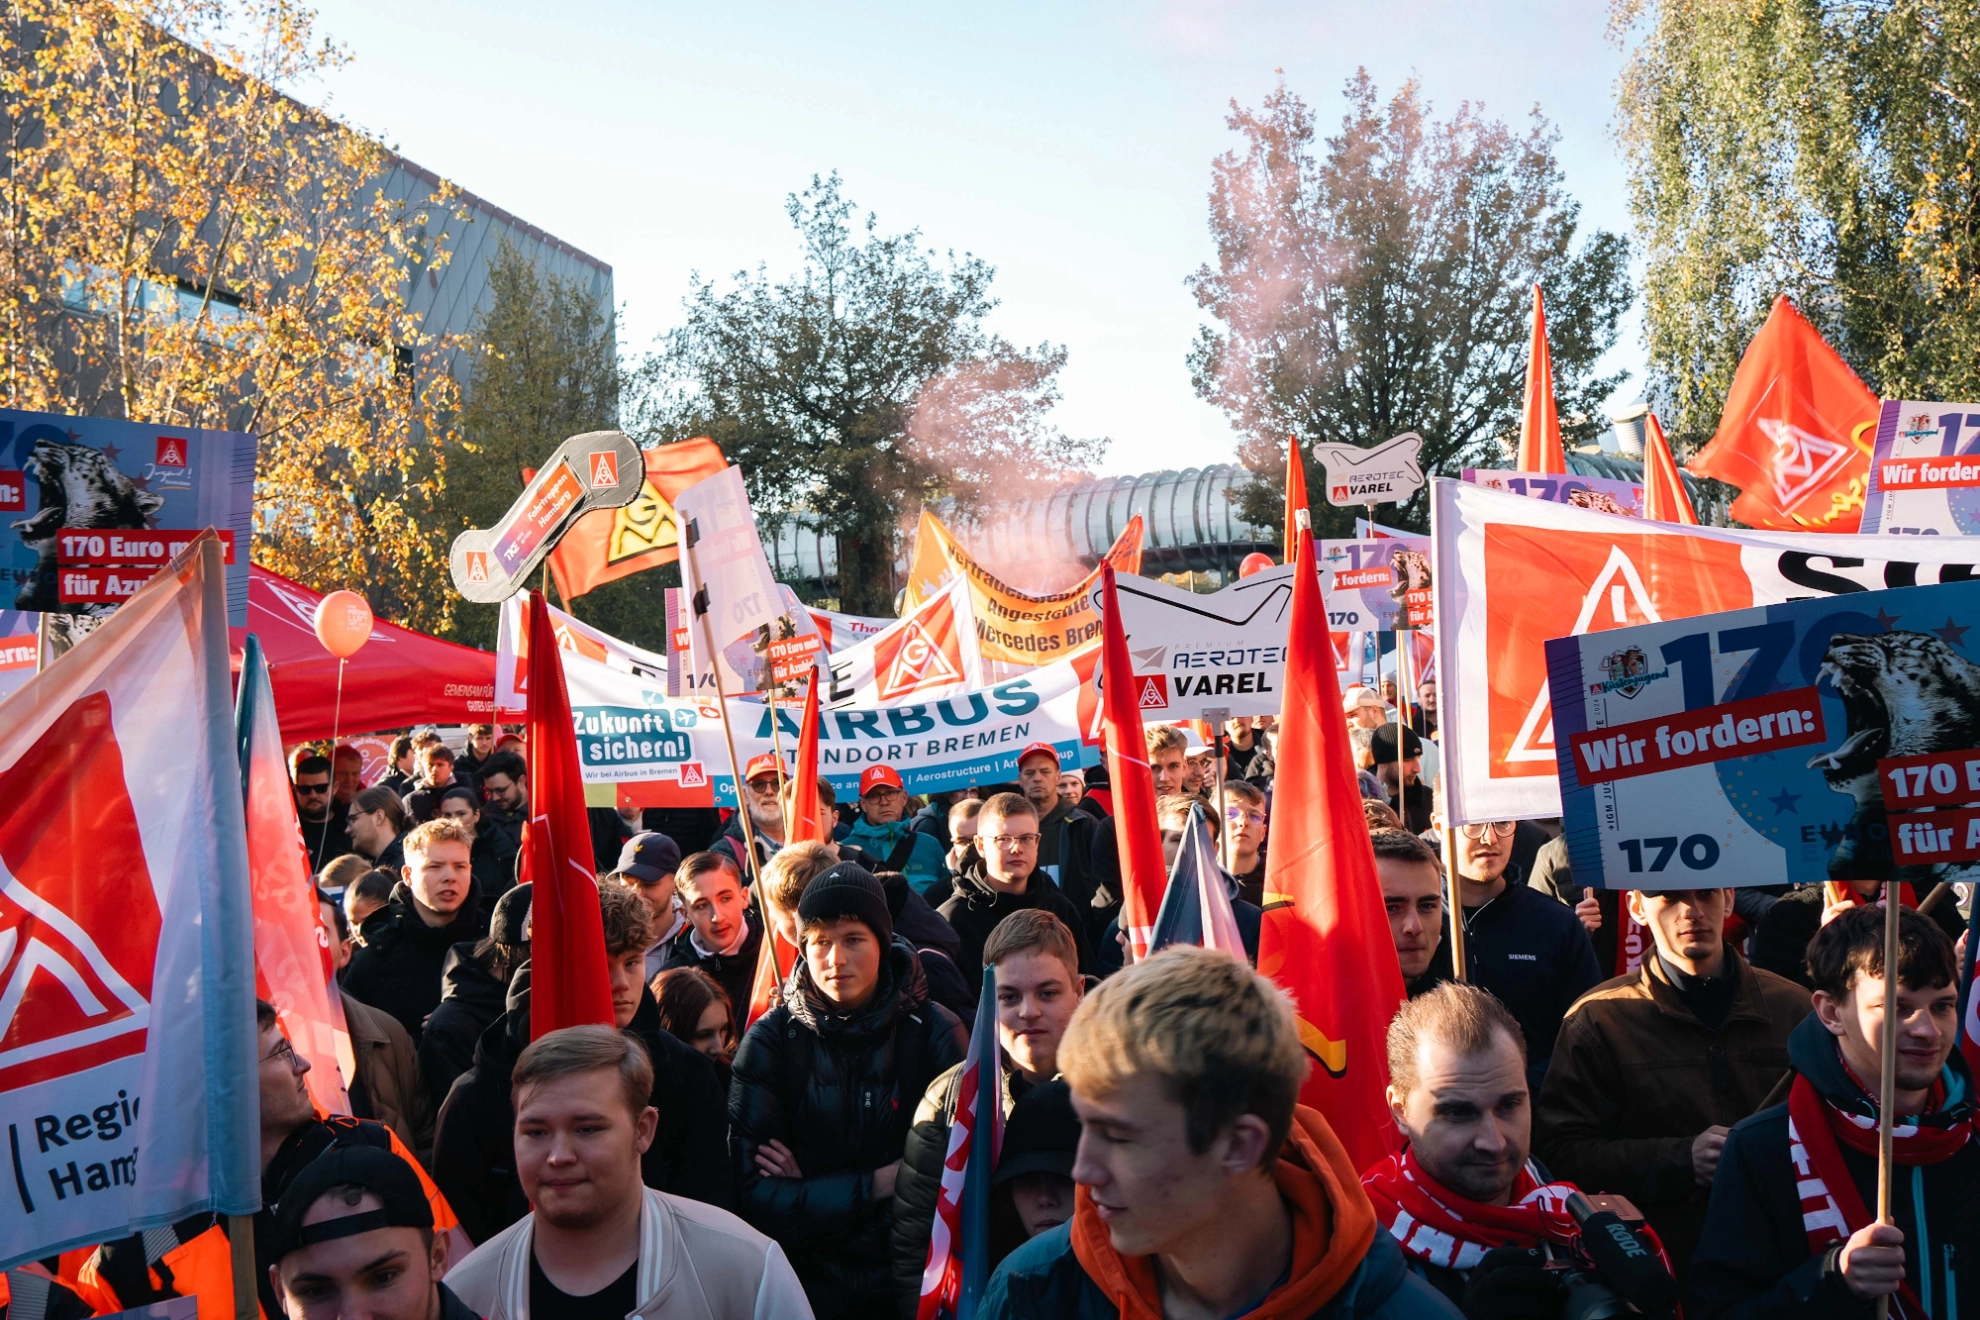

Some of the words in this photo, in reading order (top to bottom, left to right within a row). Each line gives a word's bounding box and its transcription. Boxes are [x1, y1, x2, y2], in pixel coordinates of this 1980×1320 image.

[1349, 470, 1405, 483] AEROTEC
[1882, 464, 1916, 484] Wir
[527, 474, 568, 522] Fahrtreppen
[1350, 482, 1393, 495] VAREL
[537, 489, 572, 528] Hamburg
[61, 536, 105, 558] 170
[110, 536, 164, 558] Euro
[64, 574, 99, 596] für
[1342, 571, 1390, 586] fordern:
[1408, 591, 1425, 603] 170
[1328, 611, 1359, 625] 170
[1409, 609, 1425, 622] für
[974, 616, 1061, 652] Mercedes
[1174, 639, 1244, 650] PREMIUM
[770, 643, 787, 658] 170
[786, 641, 804, 655] Euro
[1173, 646, 1288, 669] AEROTE
[774, 665, 788, 679] für
[1174, 671, 1272, 697] VAREL
[755, 678, 1040, 740] AIRBUS
[574, 710, 666, 735] Zukunft
[590, 735, 685, 761] sichern!
[927, 722, 1030, 756] BREMEN
[1579, 731, 1646, 773] Wir
[1655, 708, 1816, 760] fordern:
[768, 742, 918, 764] TNDORT
[585, 771, 600, 779] Wir
[601, 770, 612, 778] bei
[614, 769, 638, 777] Airbus
[649, 767, 678, 776] Bremen
[916, 764, 991, 783] Aerostructure
[1888, 763, 1957, 798] 170
[1898, 822, 1954, 855] für
[1618, 834, 1720, 873] 170
[1508, 953, 1537, 961] SIEMENS
[48, 1147, 140, 1201] Ham
